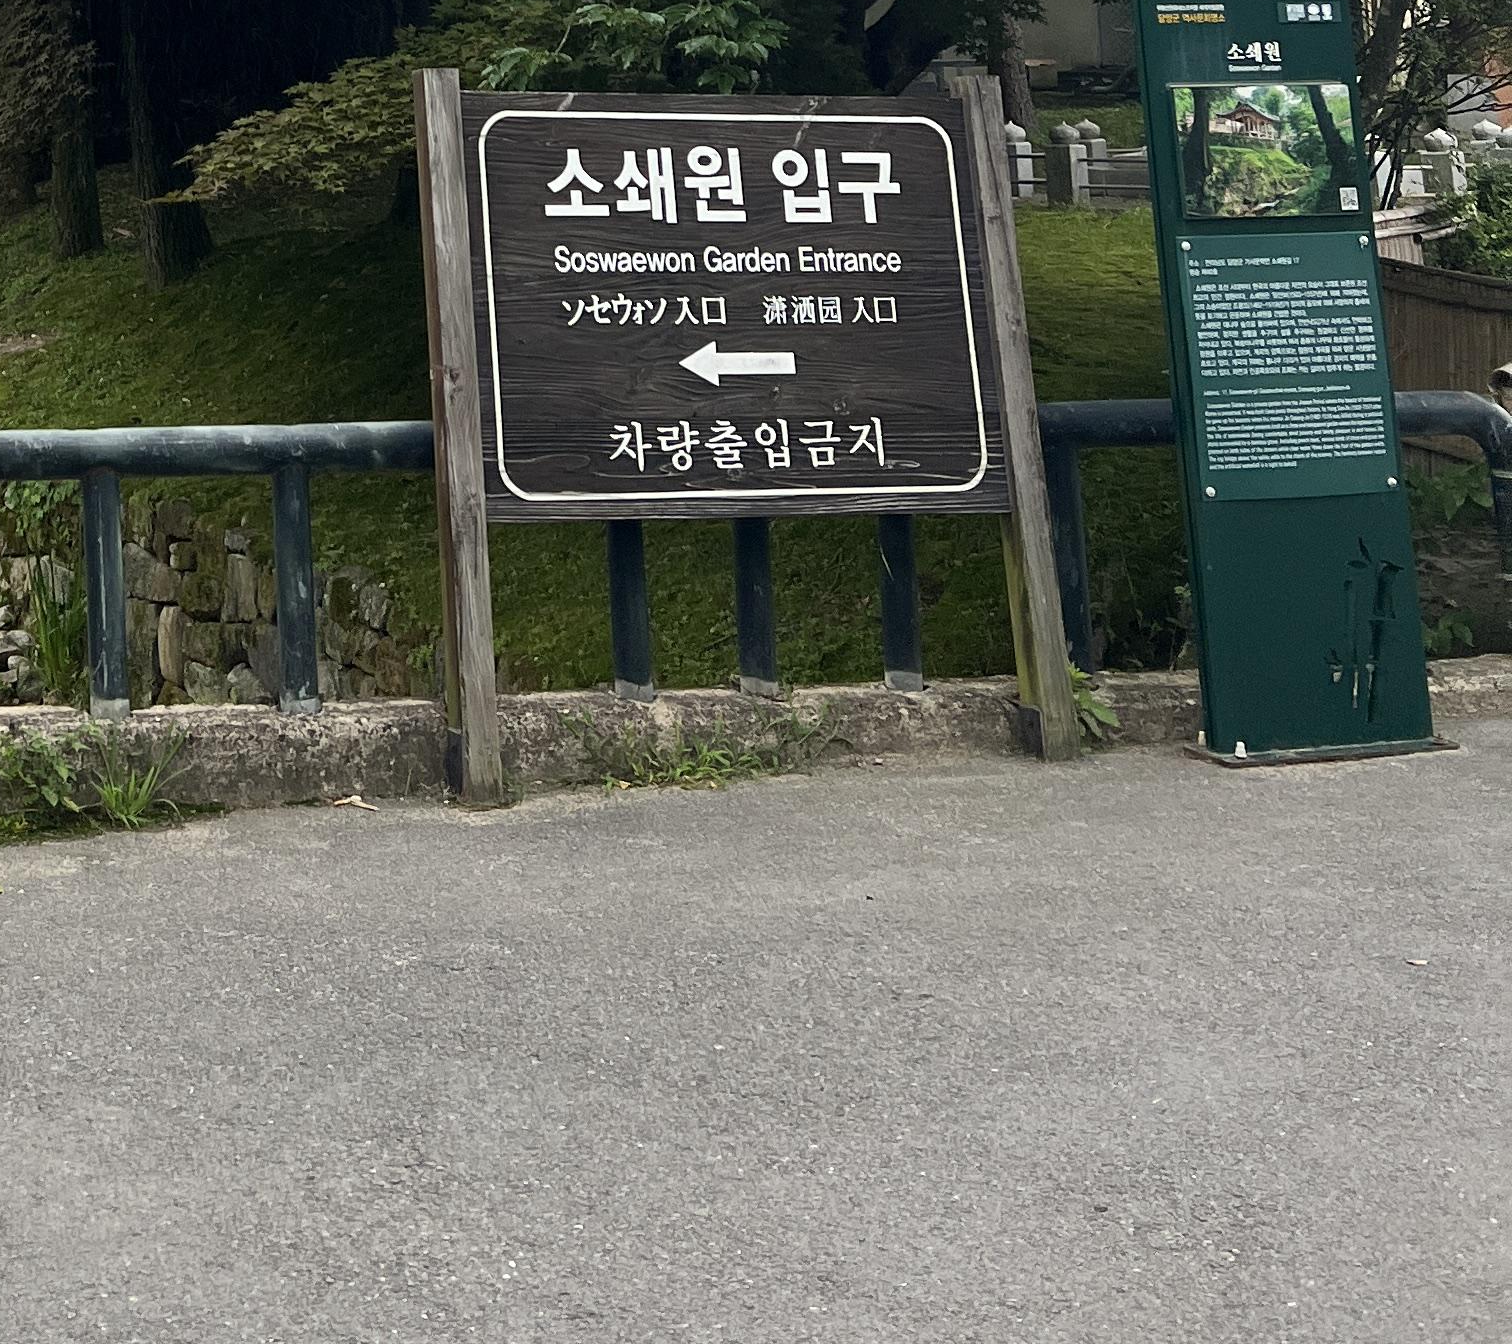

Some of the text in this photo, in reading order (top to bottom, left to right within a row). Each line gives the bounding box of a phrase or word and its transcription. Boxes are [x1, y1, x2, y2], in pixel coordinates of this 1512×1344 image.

[544, 145, 901, 224] 소쇄원 입구
[554, 245, 902, 273] Soswaewon Garden Entrance
[609, 416, 885, 472] 차량출입금지
